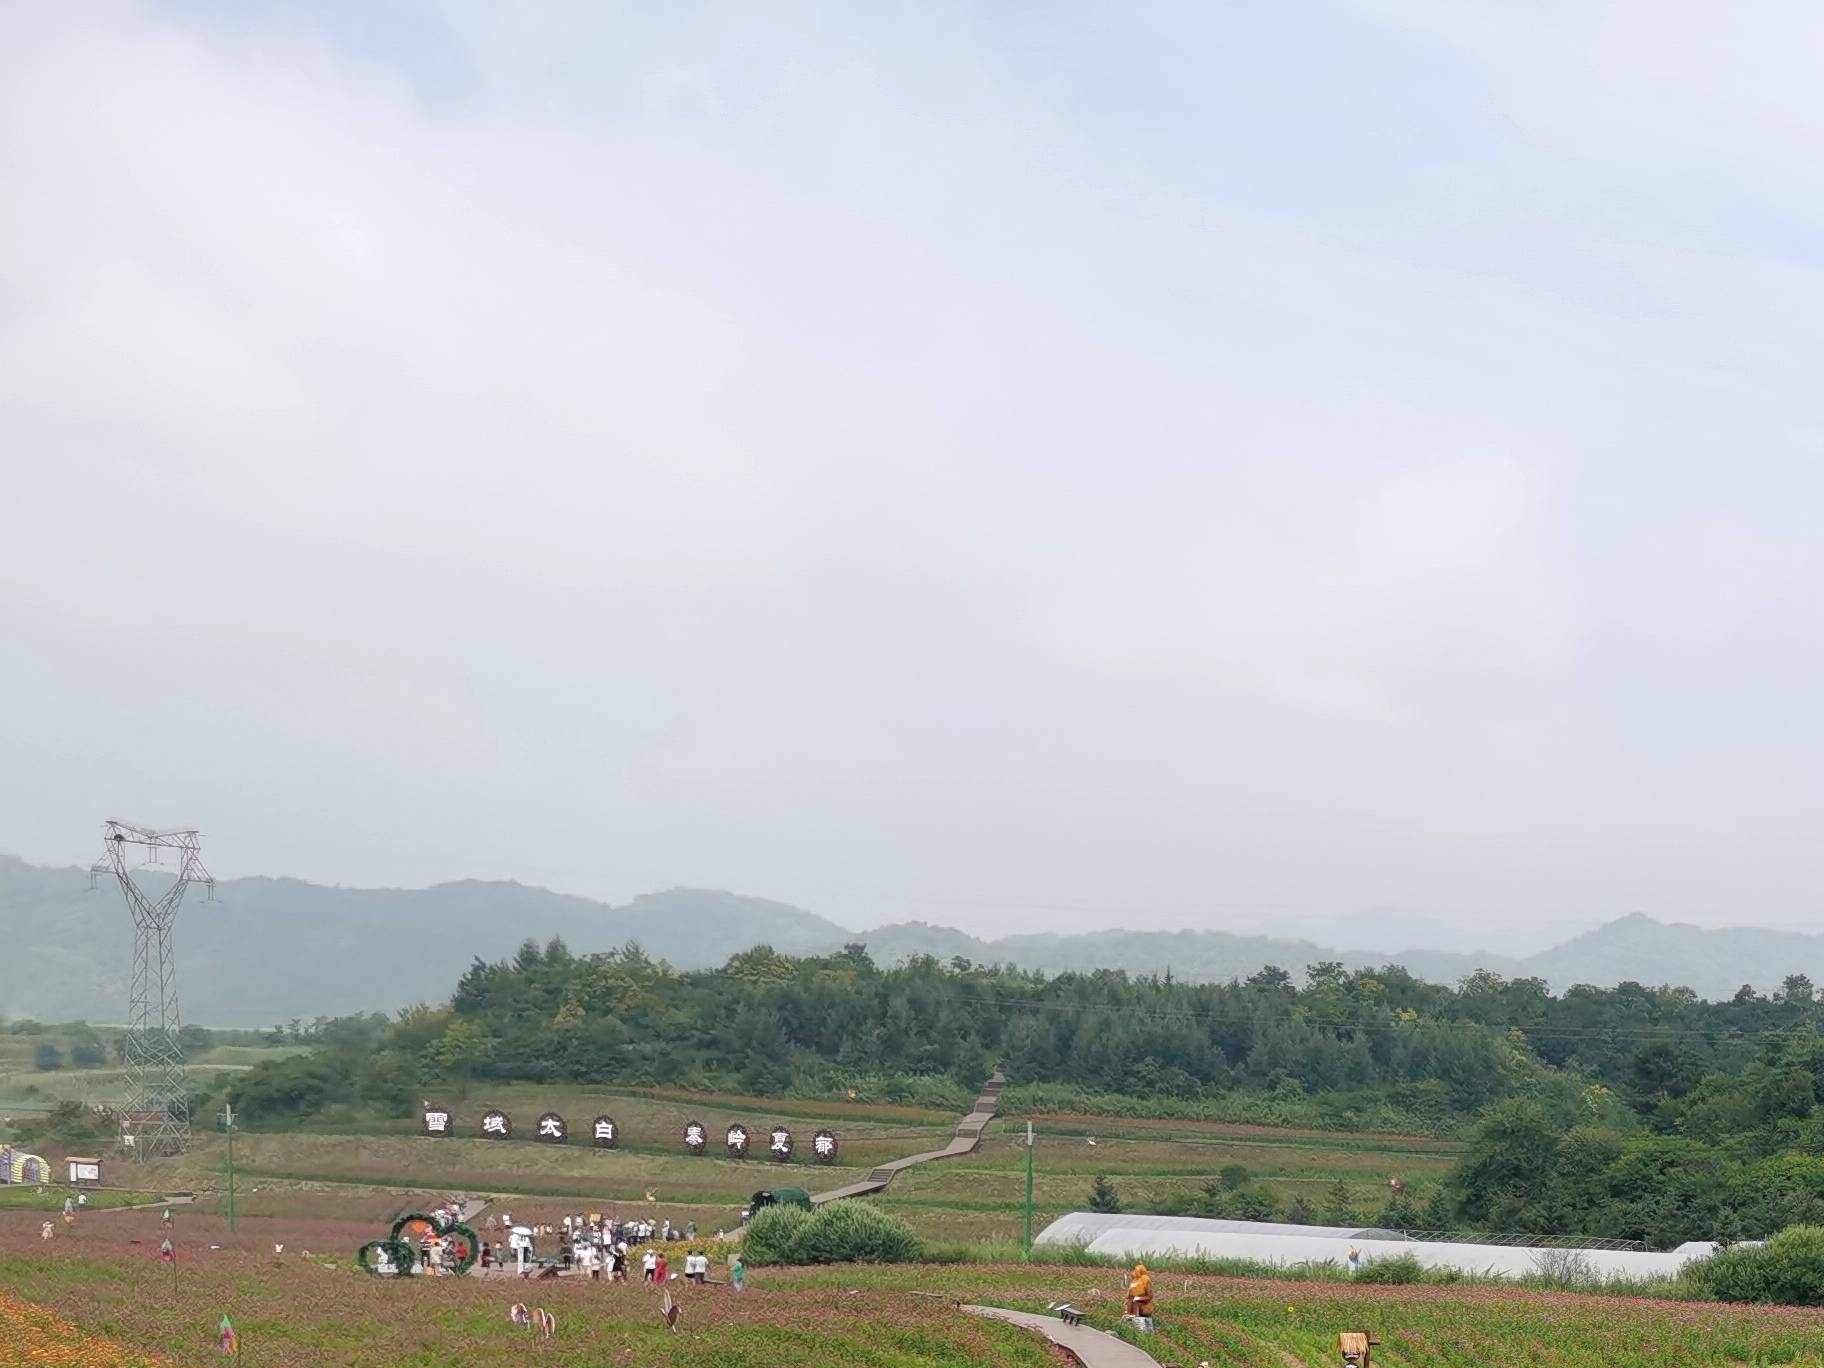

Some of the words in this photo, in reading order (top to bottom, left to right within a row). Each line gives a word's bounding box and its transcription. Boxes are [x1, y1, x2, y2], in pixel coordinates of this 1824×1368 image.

[425, 1112, 613, 1139] 雪域太白
[685, 1126, 833, 1155] 秦岭夏都
